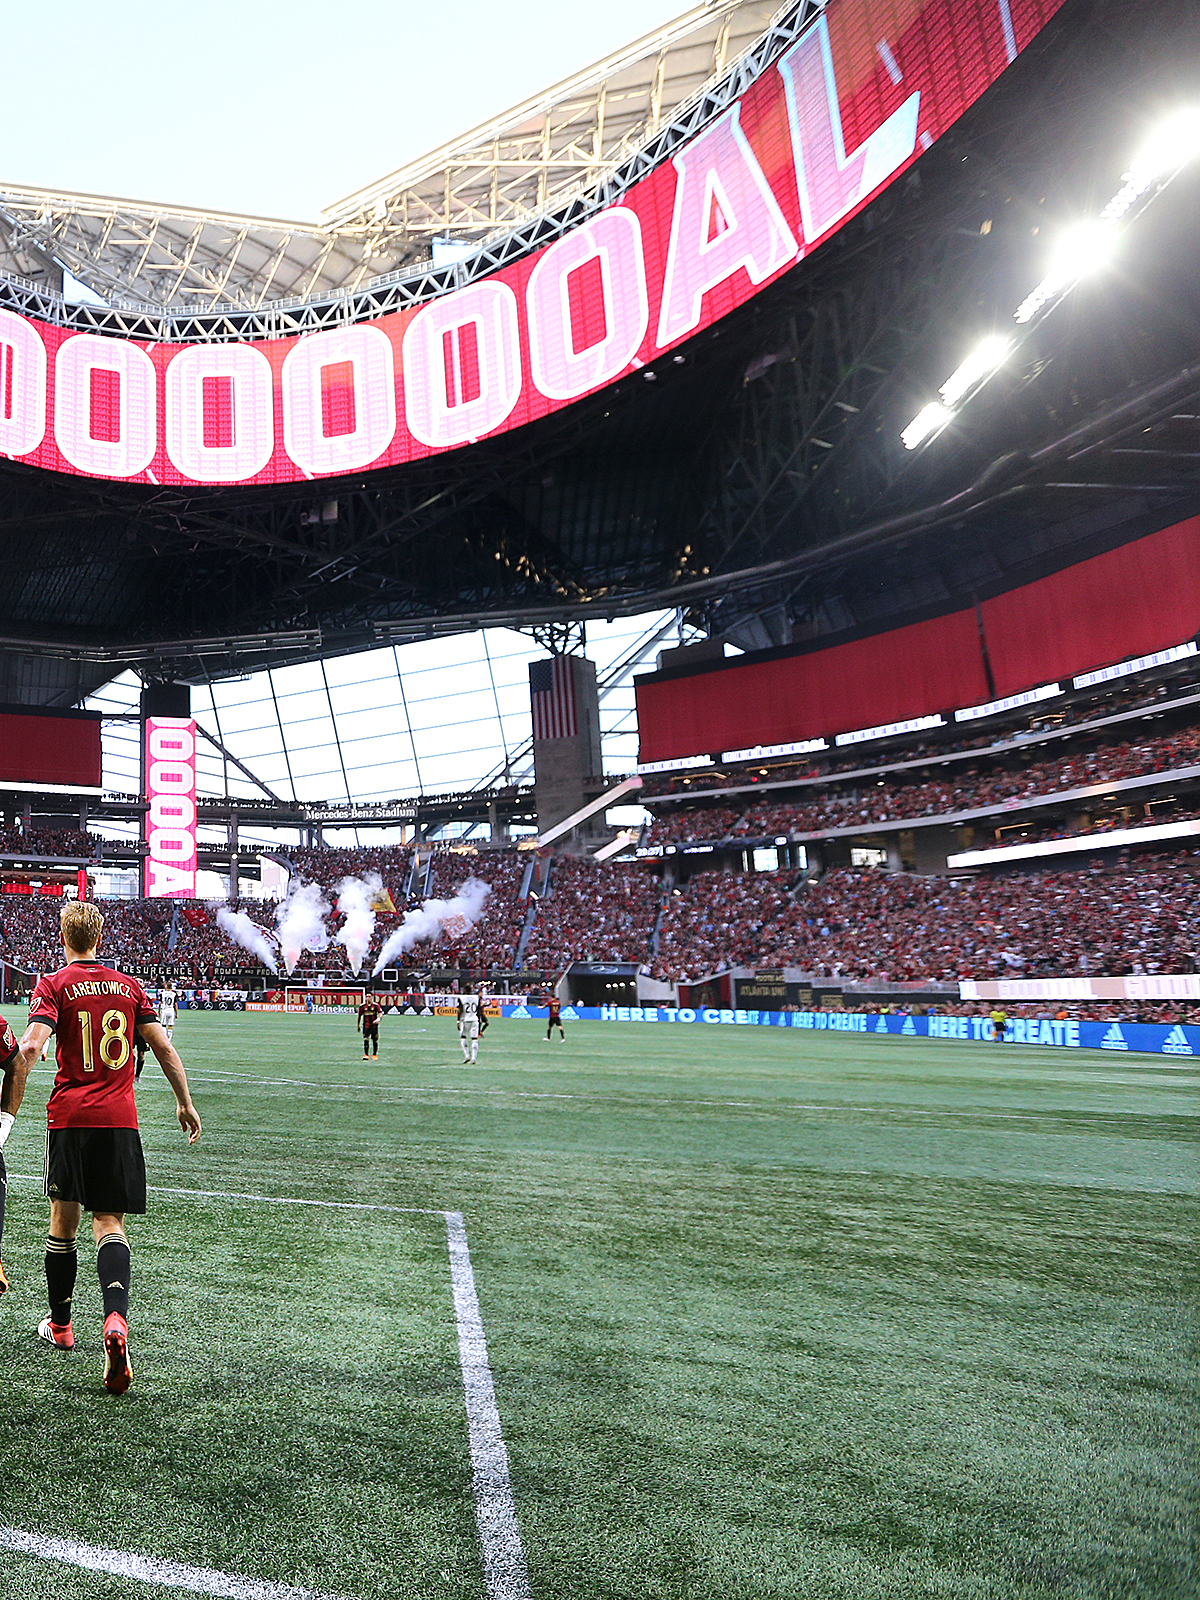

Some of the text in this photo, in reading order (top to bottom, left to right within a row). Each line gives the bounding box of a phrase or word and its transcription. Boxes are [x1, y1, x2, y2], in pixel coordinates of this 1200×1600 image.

[305, 807, 415, 820] Mercedes-Benz Stadium
[122, 966, 192, 976] RESURGENCE
[64, 980, 131, 1001] LARENTOWICZ
[166, 996, 173, 1005] 10
[262, 1003, 282, 1011] HOME
[312, 1004, 356, 1013] Heineken
[465, 1003, 478, 1013] 20
[601, 1007, 659, 1022] HERE
[663, 1008, 696, 1023] TO
[792, 1011, 867, 1032] HERE TO CREATE
[928, 1015, 1080, 1047] HERE TO CREATE
[77, 1009, 130, 1073] 18
